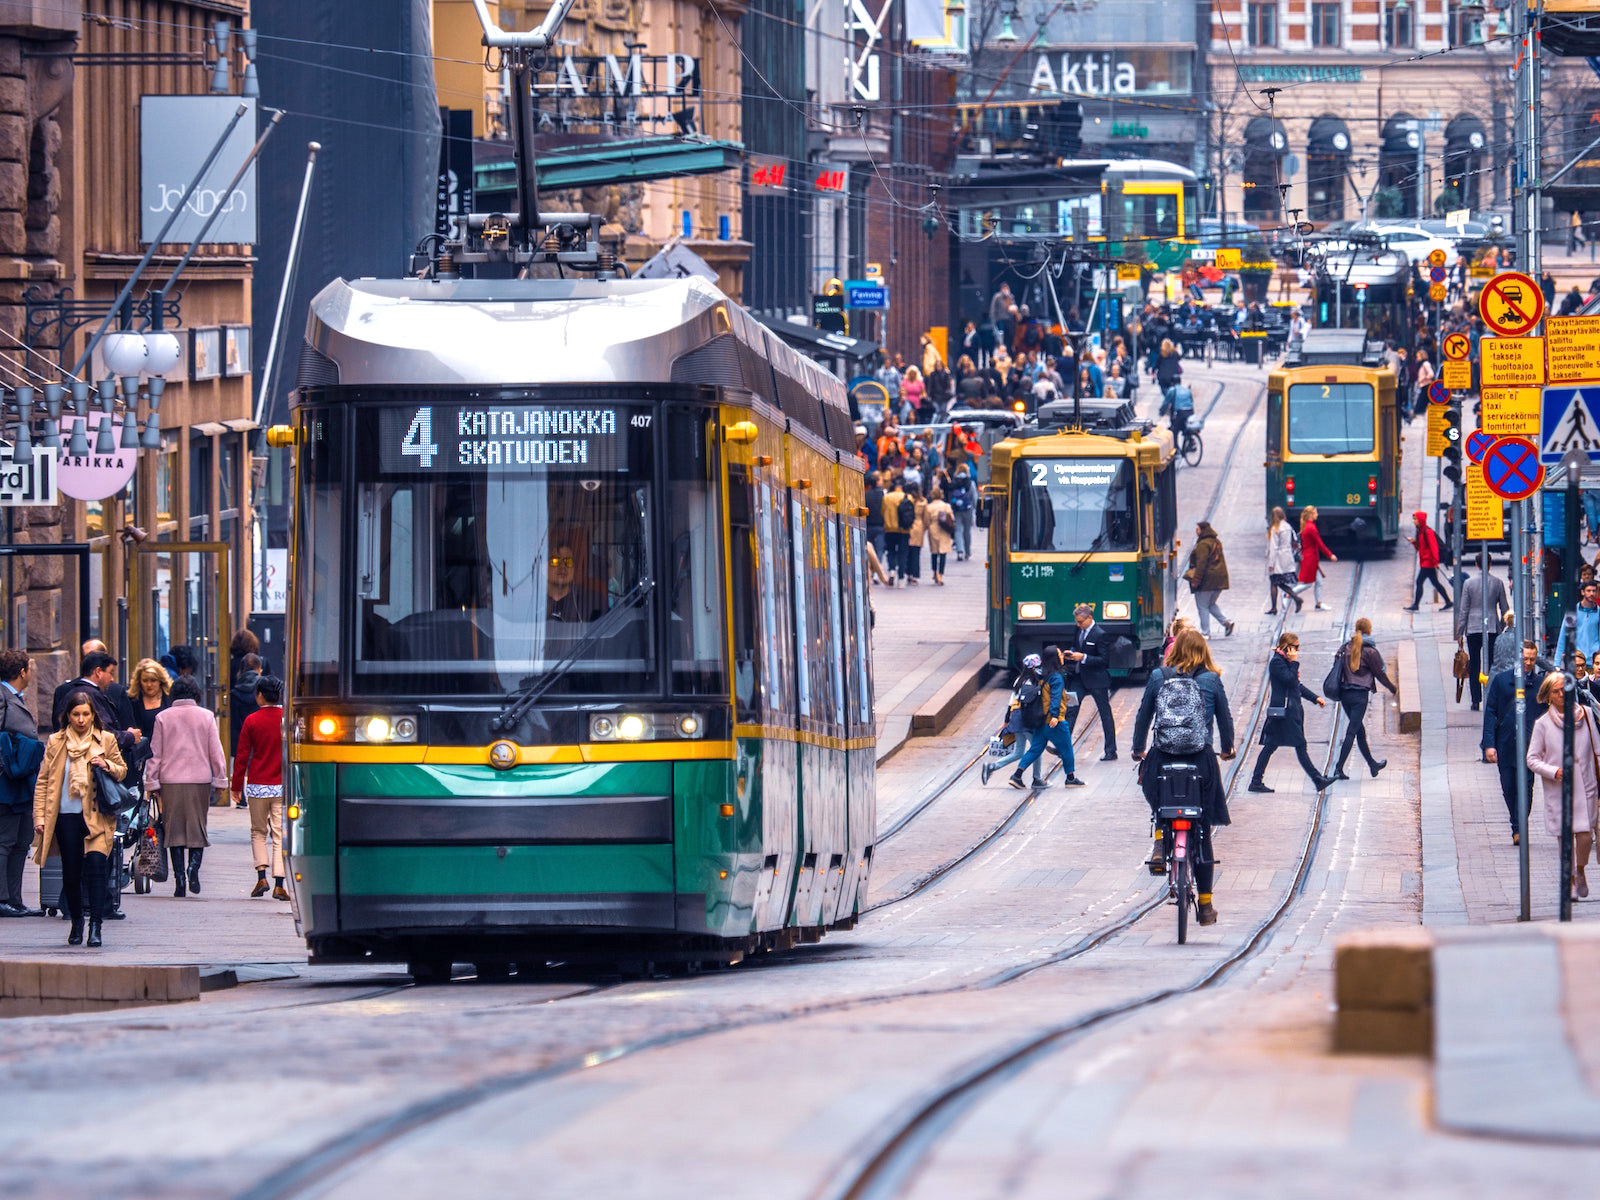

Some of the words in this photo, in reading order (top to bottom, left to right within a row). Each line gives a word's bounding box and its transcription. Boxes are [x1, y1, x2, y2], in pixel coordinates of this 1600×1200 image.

[1029, 53, 1136, 95] Aktia
[538, 111, 677, 127] ALLERIA
[437, 173, 447, 252] GLLERIA
[1489, 342, 1497, 350] Ei
[1500, 342, 1523, 350] koske
[1321, 385, 1331, 398] 2
[458, 410, 616, 436] KATAJANOKKA
[630, 415, 653, 428] 407
[401, 406, 438, 468] 4
[458, 440, 588, 465] SKATUDDEN
[57, 456, 124, 469] ARIKKA
[1031, 463, 1048, 486] 2
[1346, 493, 1361, 505] 89
